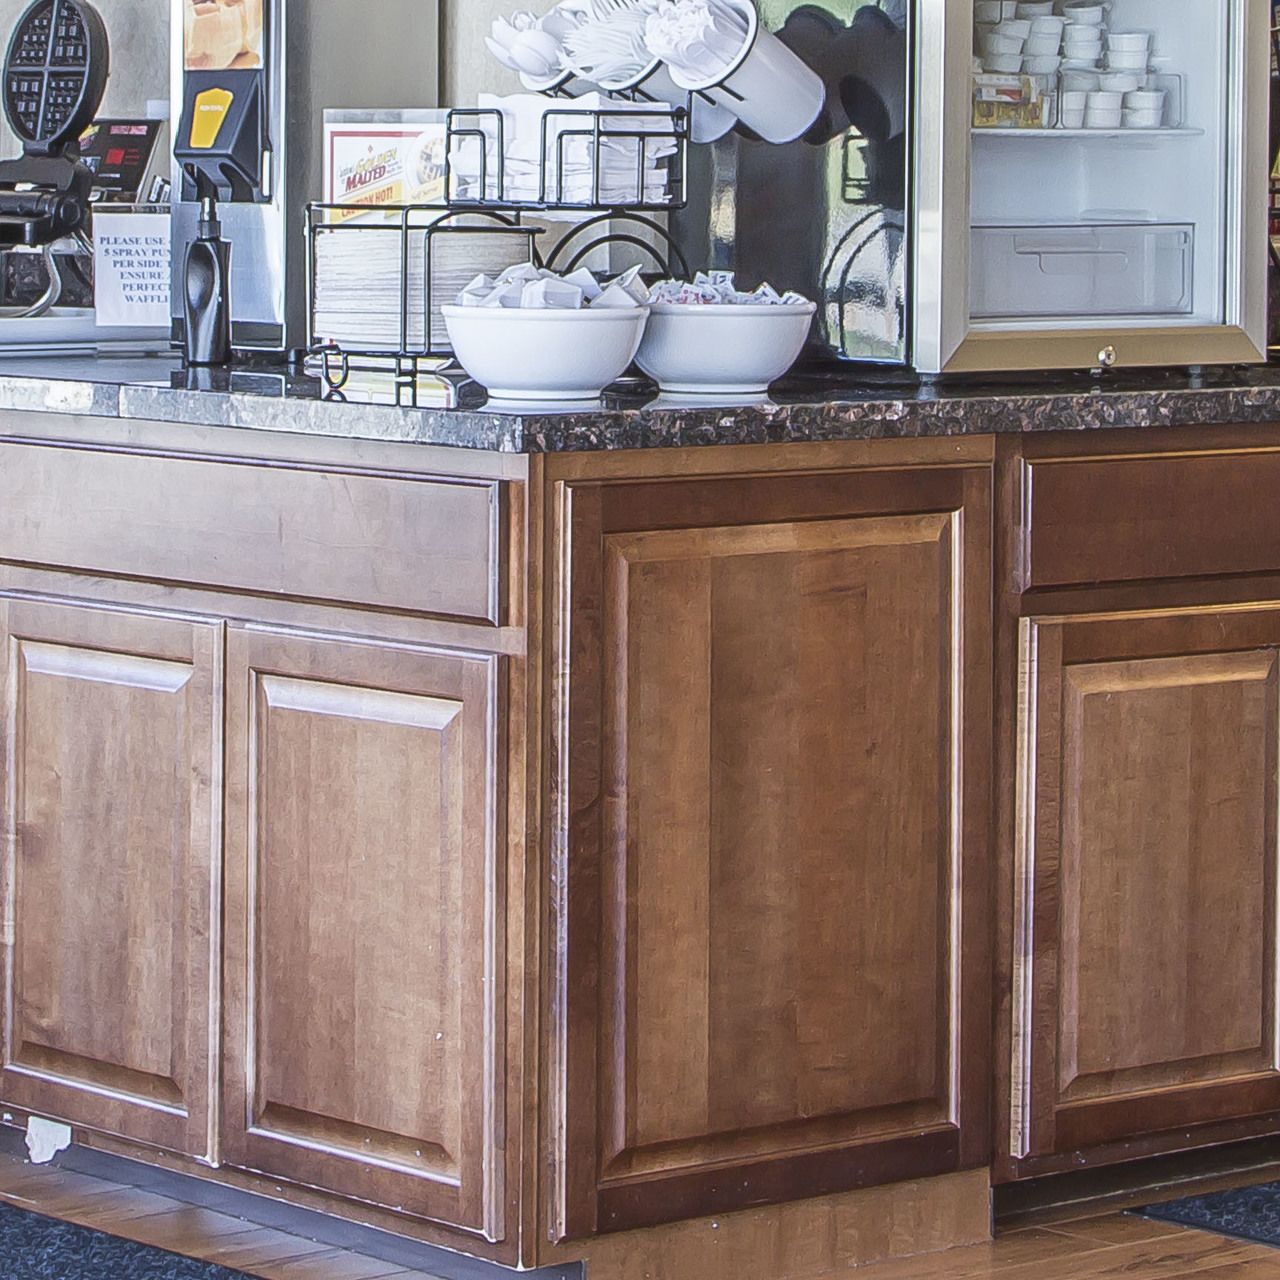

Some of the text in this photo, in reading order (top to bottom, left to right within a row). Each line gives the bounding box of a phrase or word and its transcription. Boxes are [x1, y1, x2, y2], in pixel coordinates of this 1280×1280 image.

[345, 164, 386, 192] MALTED
[99, 236, 166, 246] PLEASE USE
[111, 248, 148, 257] SPRAY
[112, 260, 135, 269] PER
[136, 260, 163, 269] SIDE
[119, 271, 165, 280] ENSURE
